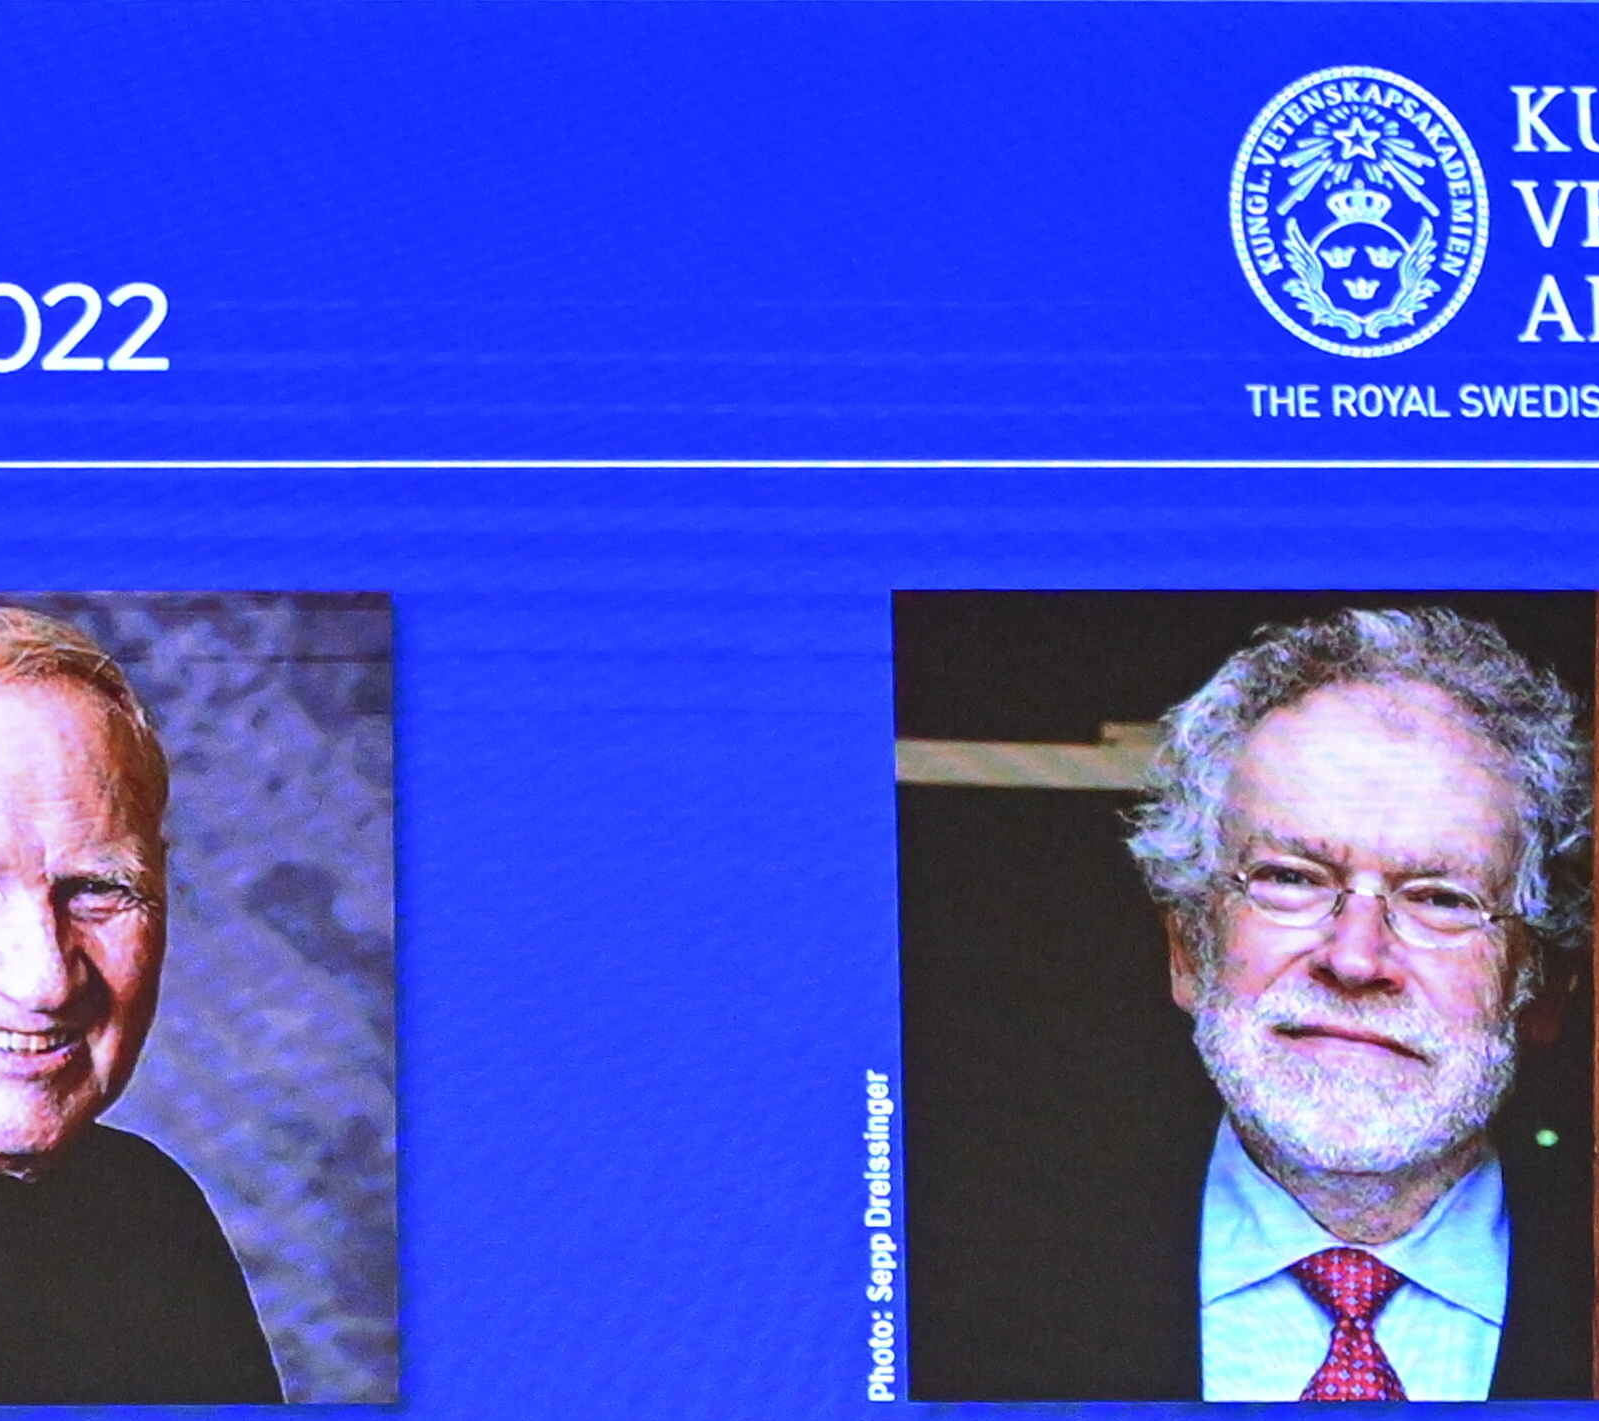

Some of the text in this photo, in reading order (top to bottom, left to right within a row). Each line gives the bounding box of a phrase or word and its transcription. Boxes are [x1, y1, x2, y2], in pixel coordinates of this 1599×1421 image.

[1244, 383, 1322, 419] THE
[1331, 382, 1452, 419] ROYAL
[862, 1068, 898, 1403] Photo: Sepp Dreissinger
